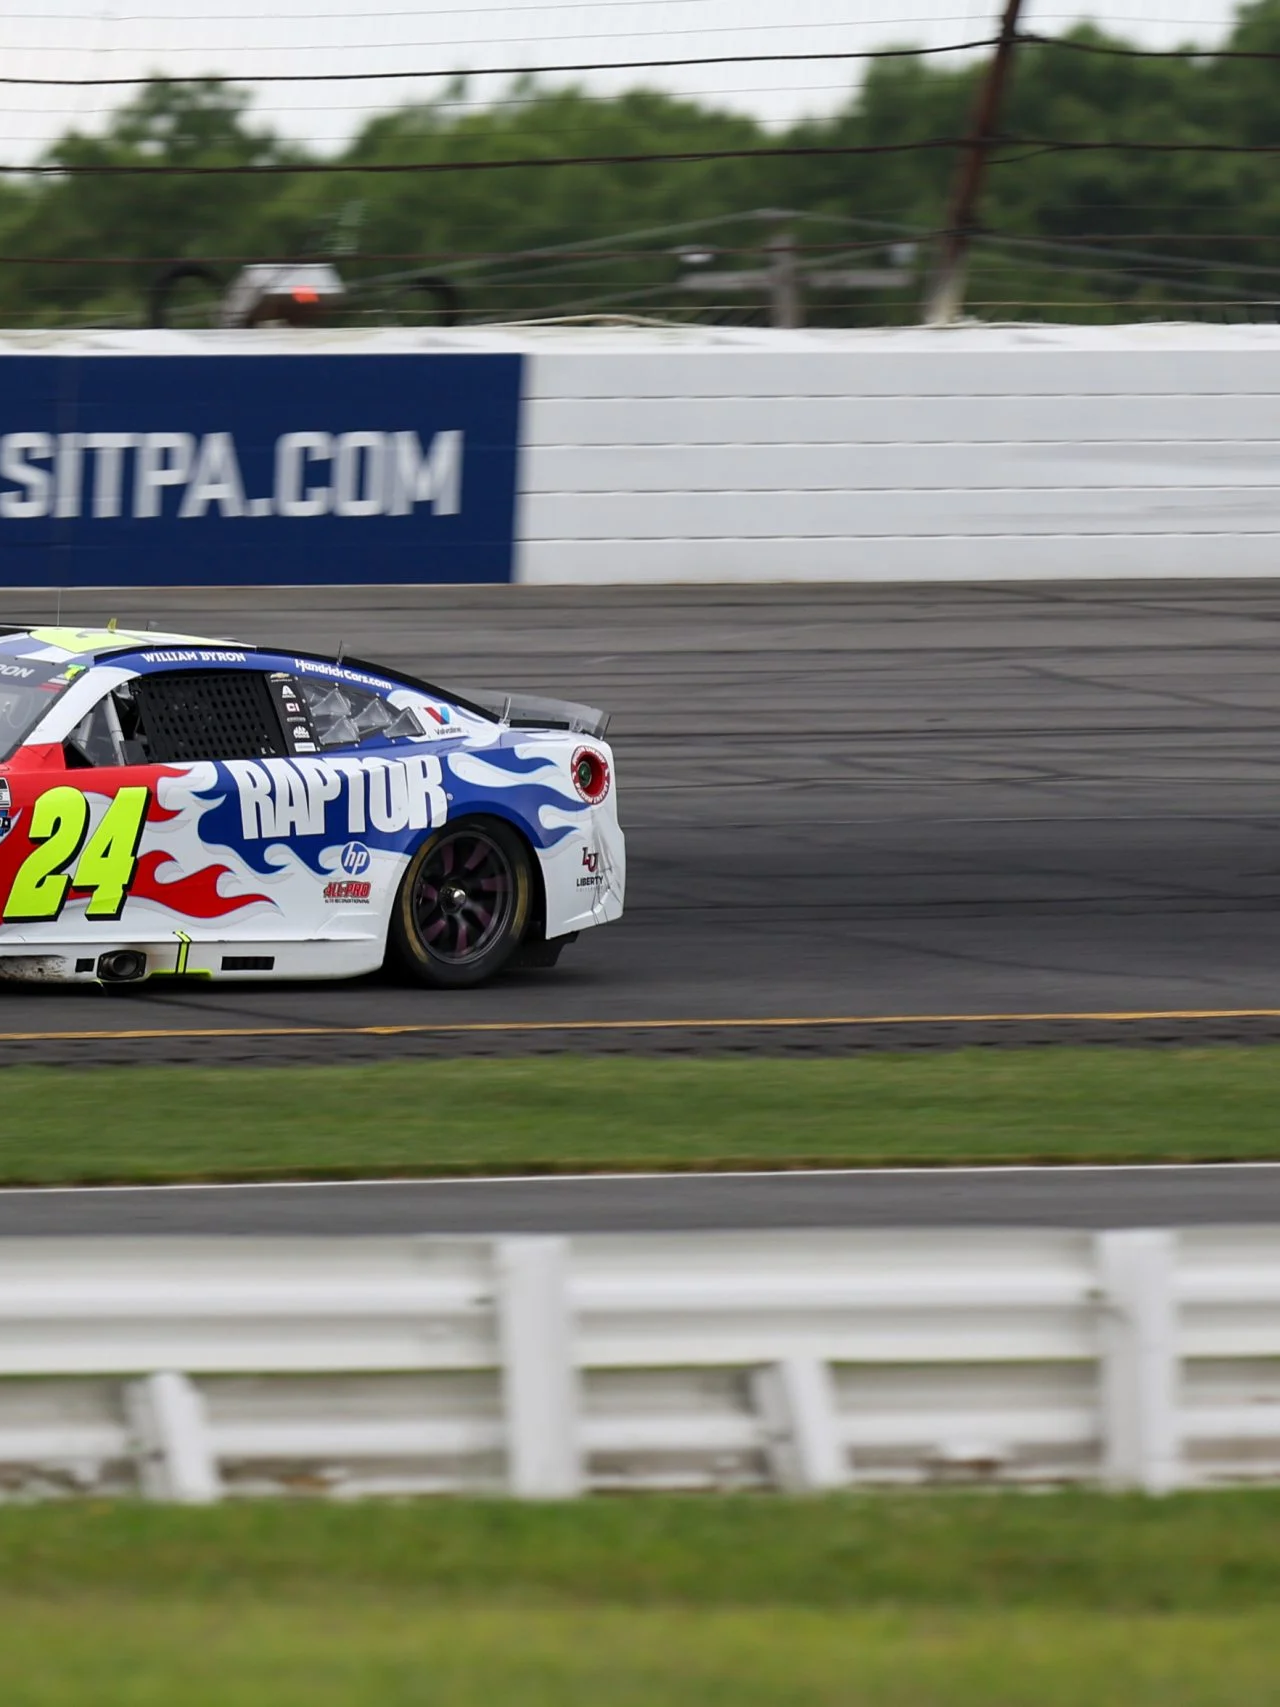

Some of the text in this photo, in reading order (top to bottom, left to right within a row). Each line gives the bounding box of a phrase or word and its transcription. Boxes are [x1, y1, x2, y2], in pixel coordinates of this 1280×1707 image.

[141, 651, 246, 662] WILLIAM BYRON
[221, 754, 448, 840] RAPTOR
[3, 786, 153, 923] 24
[343, 842, 368, 875] hp
[576, 876, 604, 887] LIBERTY
